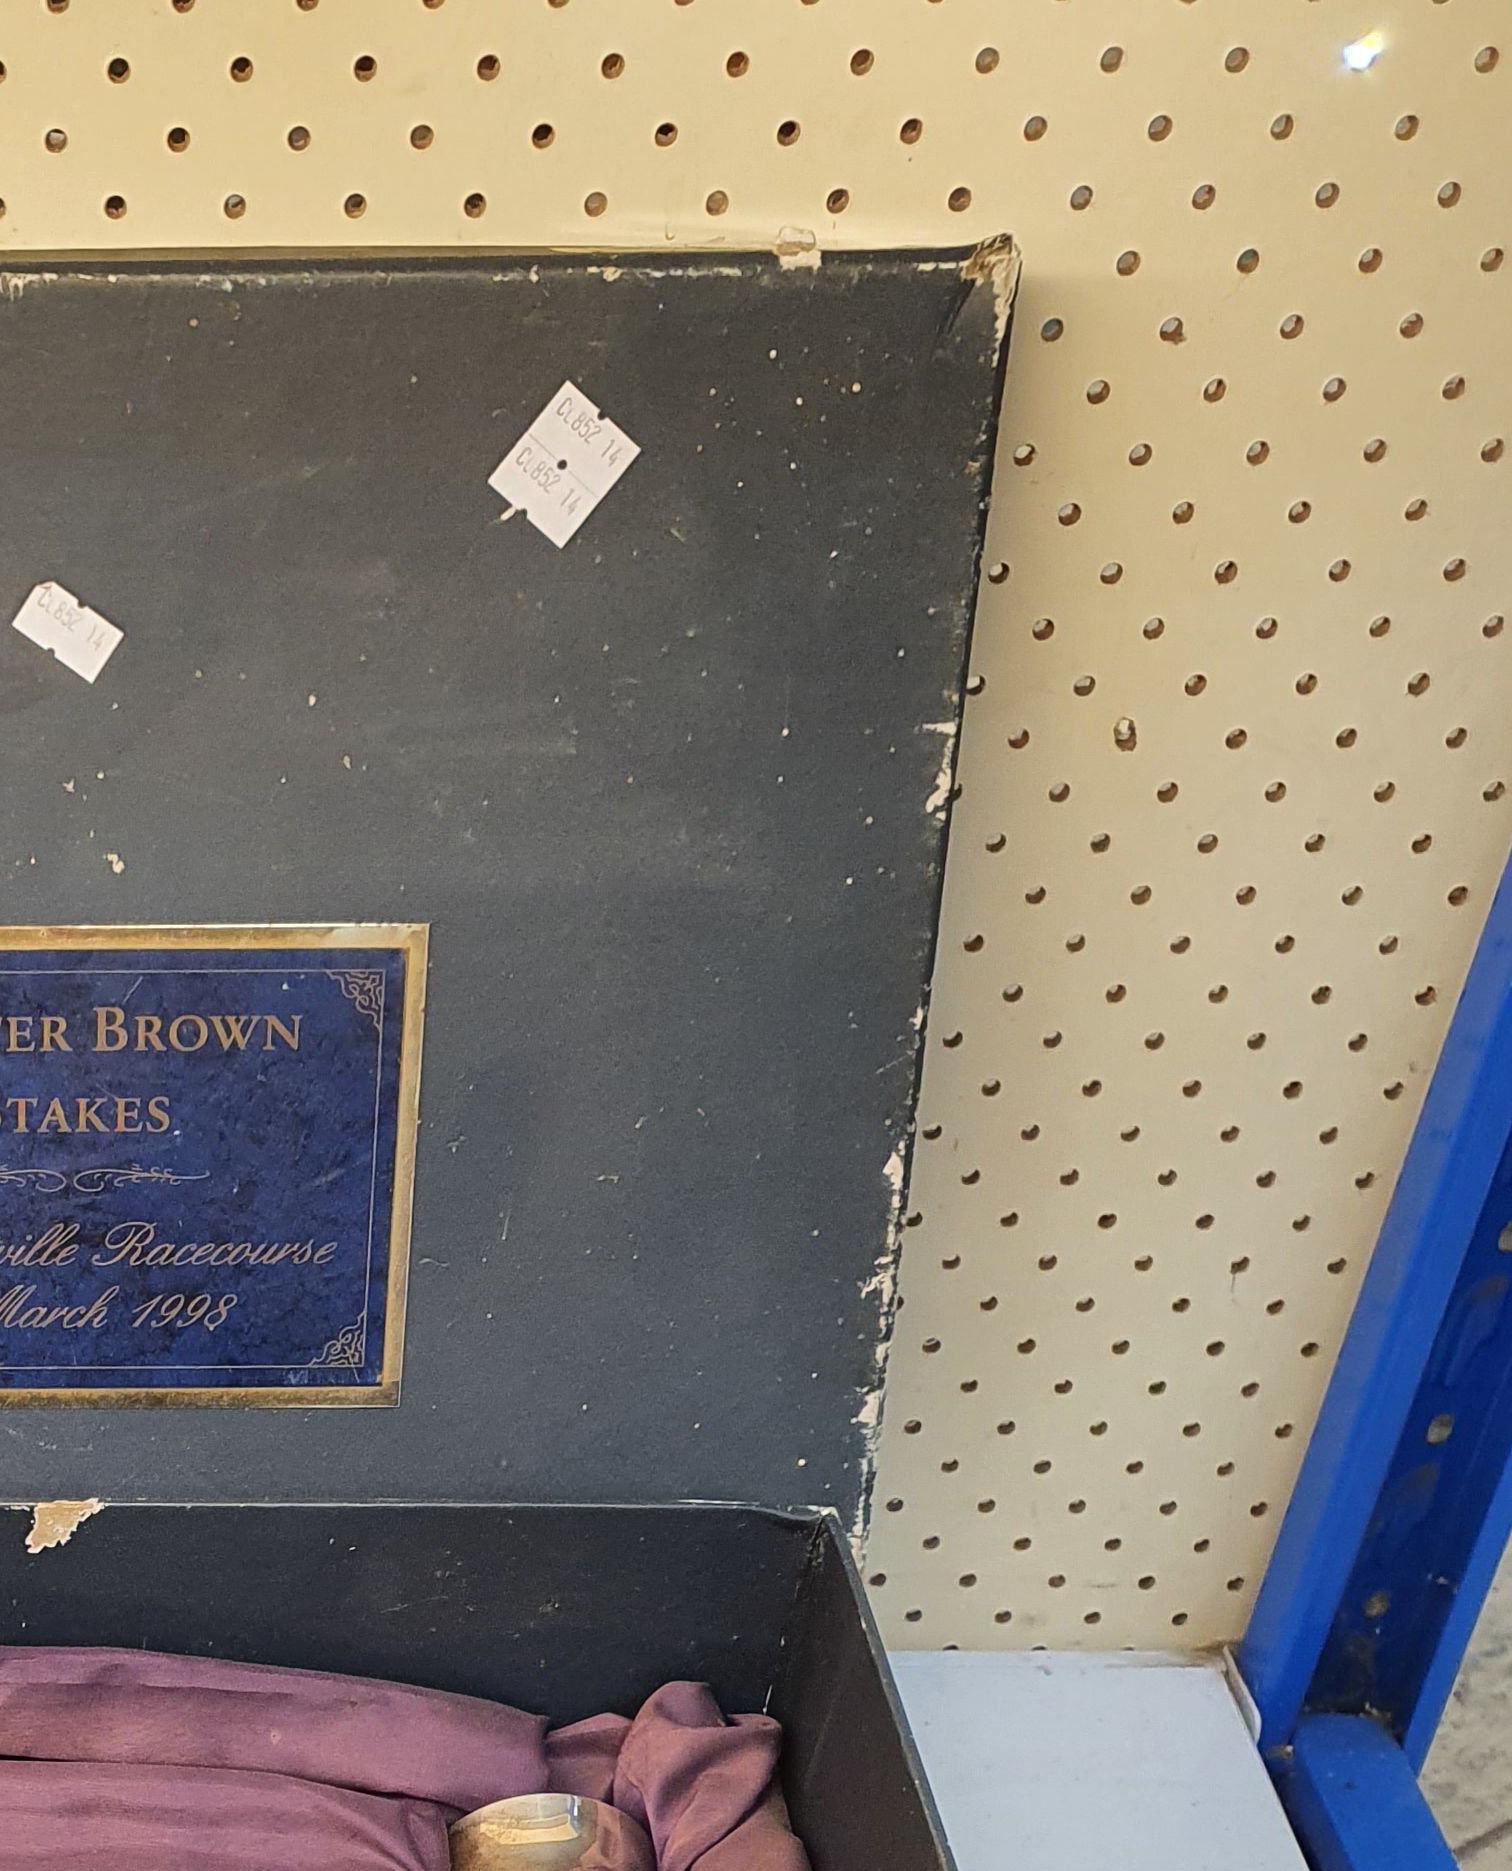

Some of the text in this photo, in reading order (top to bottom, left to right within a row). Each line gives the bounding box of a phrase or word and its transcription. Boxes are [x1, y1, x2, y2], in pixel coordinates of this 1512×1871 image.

[600, 439, 623, 467] 14
[560, 488, 582, 515] 14
[92, 1006, 303, 1052] BROWN
[91, 1221, 339, 1267] Racecourse
[133, 1293, 239, 1332] 1998
